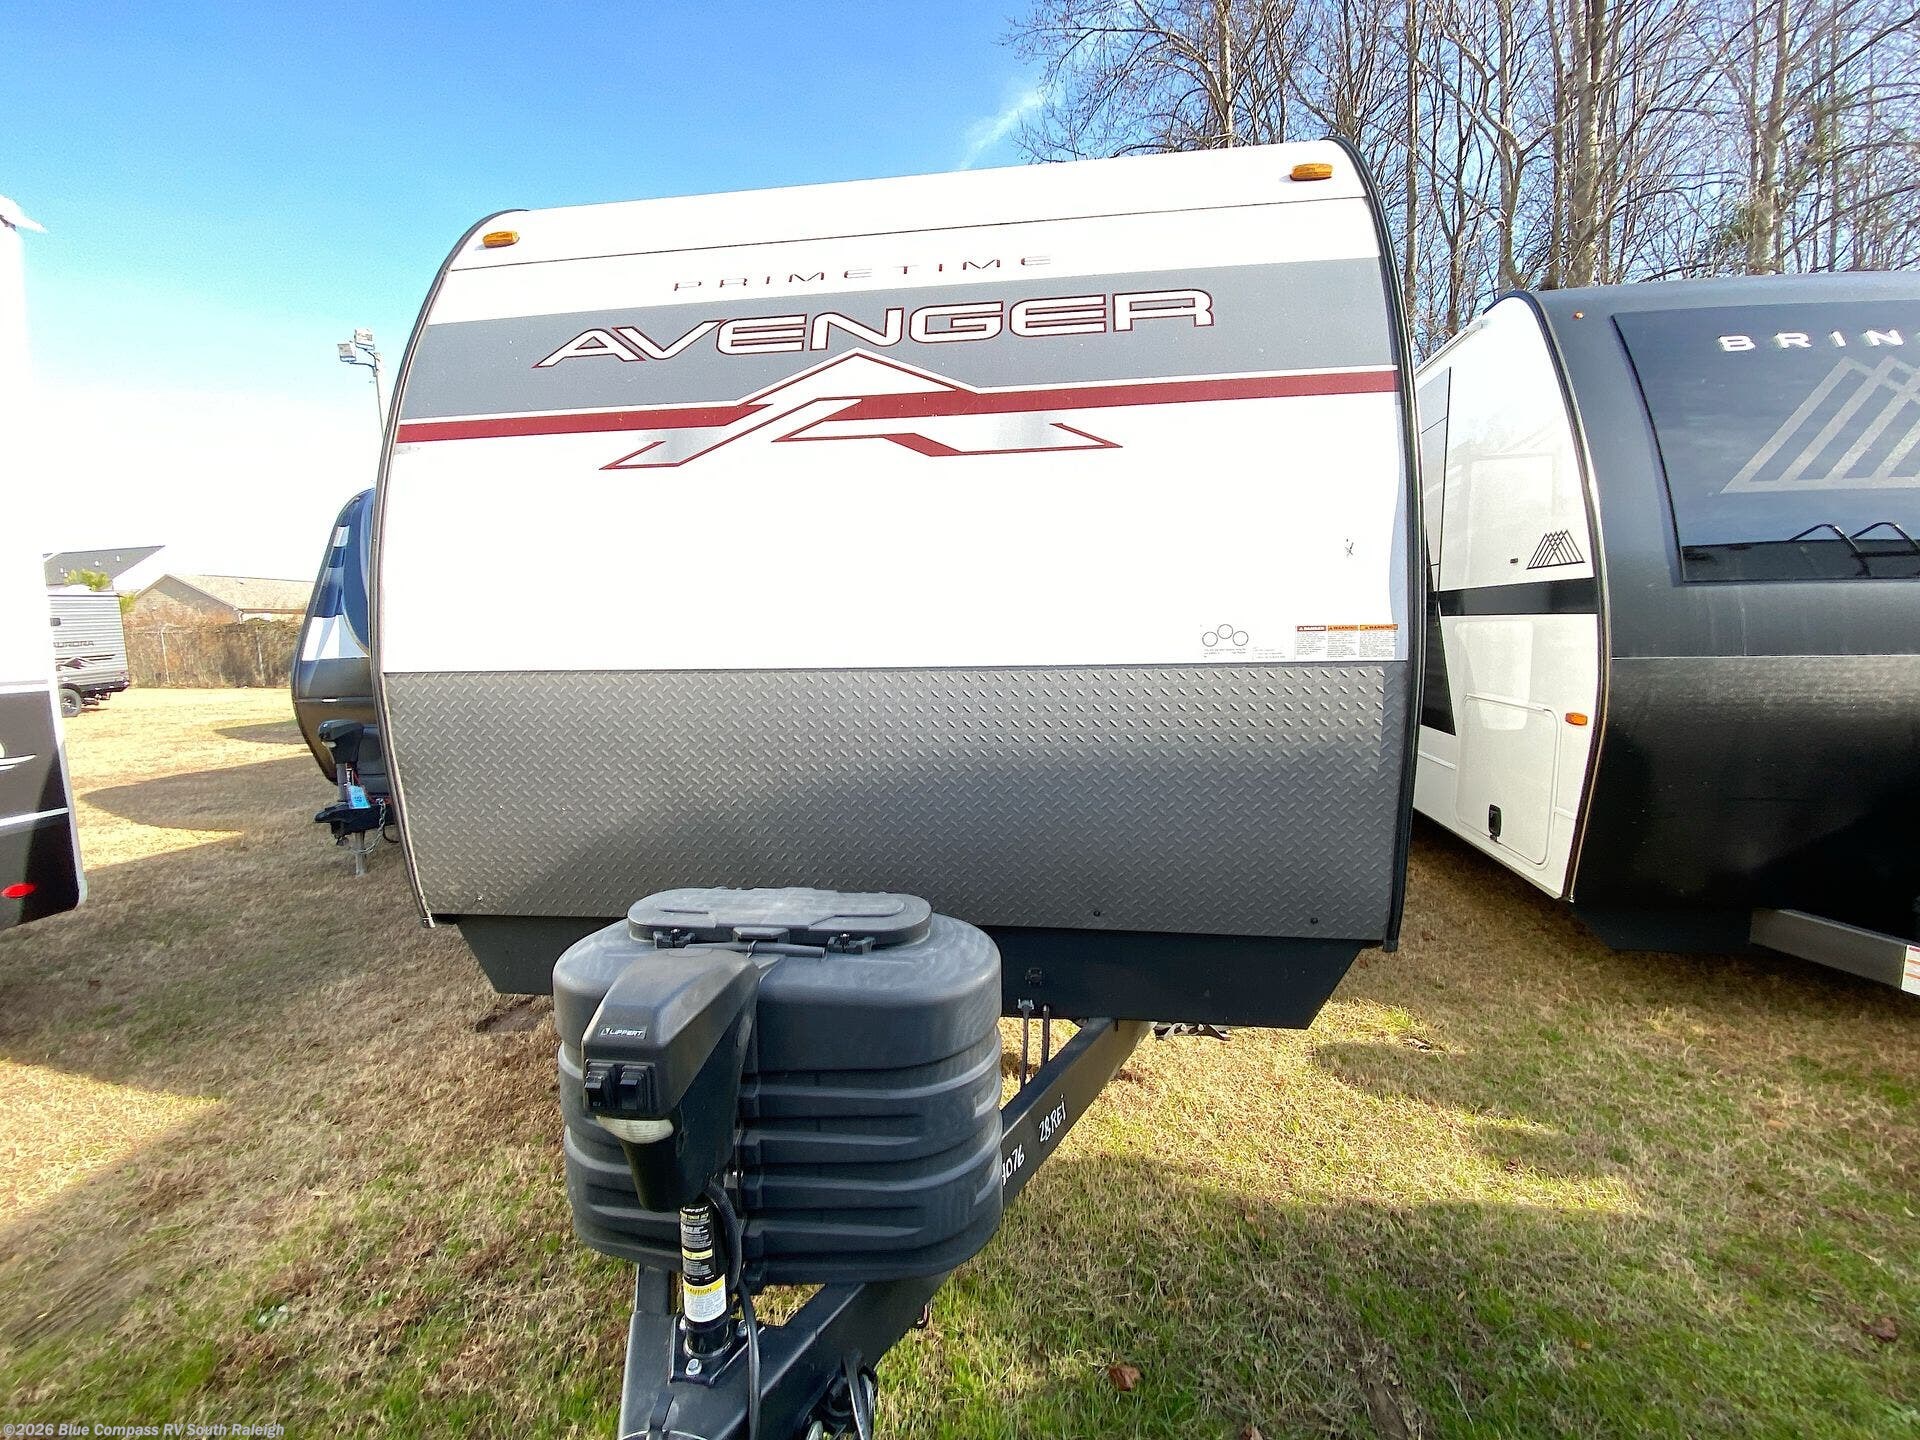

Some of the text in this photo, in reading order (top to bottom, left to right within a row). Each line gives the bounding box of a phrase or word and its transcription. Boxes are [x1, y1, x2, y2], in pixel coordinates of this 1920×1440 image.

[533, 288, 1215, 369] AVENGER
[609, 1029, 643, 1037] LIPPERT
[687, 1287, 712, 1296] CAUTION
